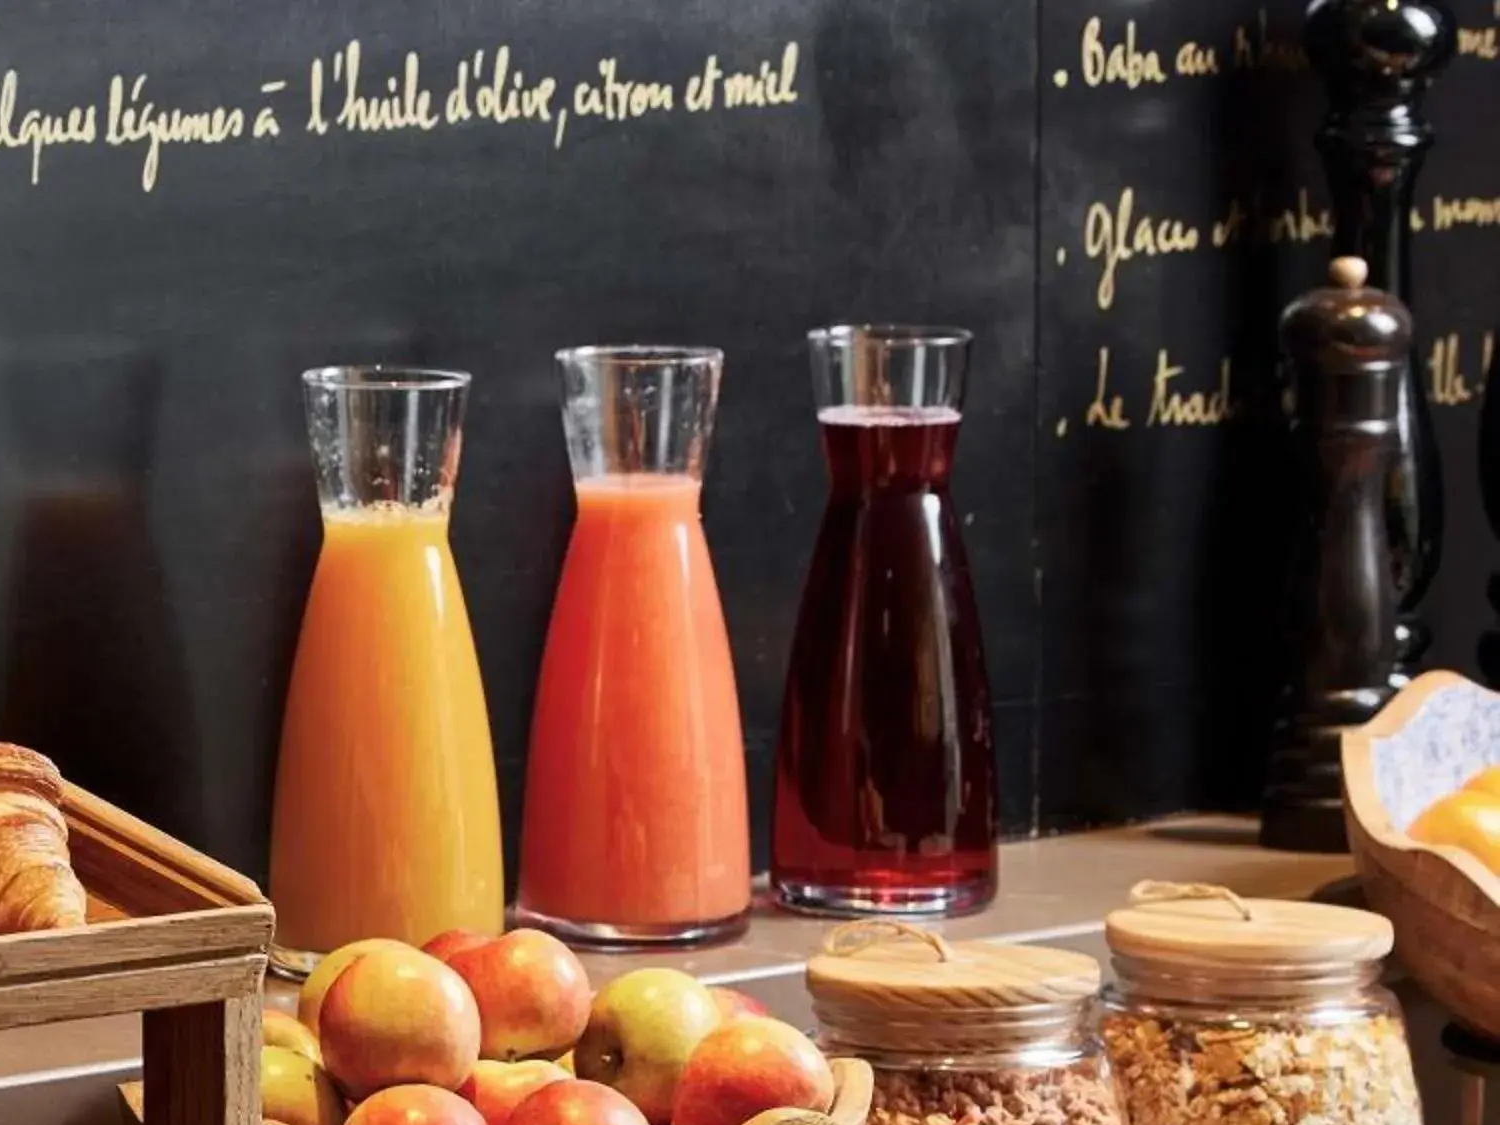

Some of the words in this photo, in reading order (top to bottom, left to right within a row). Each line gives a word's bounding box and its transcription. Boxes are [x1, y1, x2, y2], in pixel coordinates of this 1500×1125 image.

[1081, 16, 1168, 90] Baba
[105, 74, 244, 193] légumes
[306, 39, 439, 135] l'huile
[574, 57, 674, 121] citron
[685, 55, 723, 112] et
[723, 41, 799, 108] miel
[1086, 346, 1132, 430] Le
[1146, 348, 1238, 428] trad
